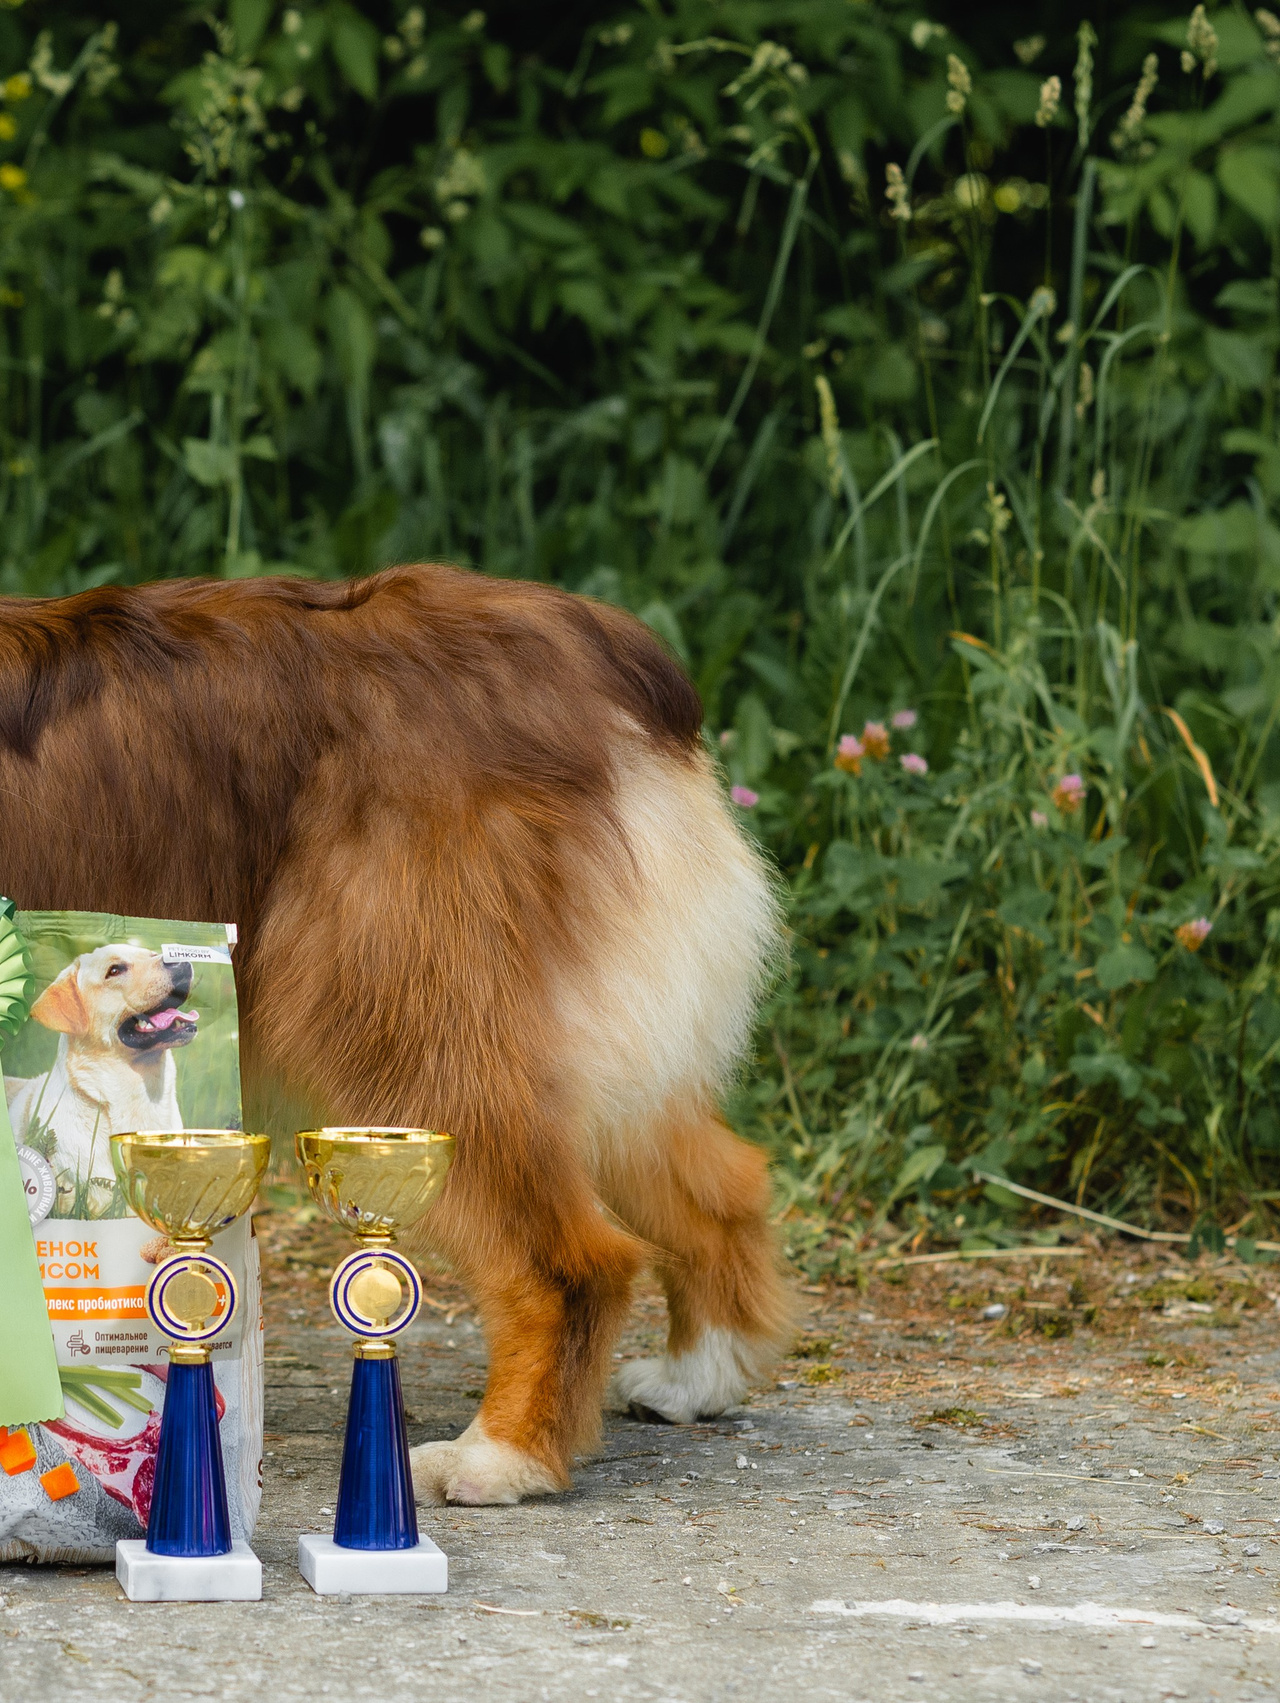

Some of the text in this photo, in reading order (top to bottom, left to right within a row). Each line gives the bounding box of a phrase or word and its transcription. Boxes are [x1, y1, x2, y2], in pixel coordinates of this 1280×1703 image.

[169, 951, 212, 959] LIMKORM
[16, 1145, 42, 1168] АНИЕ
[35, 1166, 53, 1217] ЖИВОТНЫХ
[36, 1240, 99, 1258] ЕНОК
[46, 1296, 145, 1314] лекс пробиотико
[94, 1331, 148, 1342] Оптимальное
[95, 1344, 149, 1356] пищеварение
